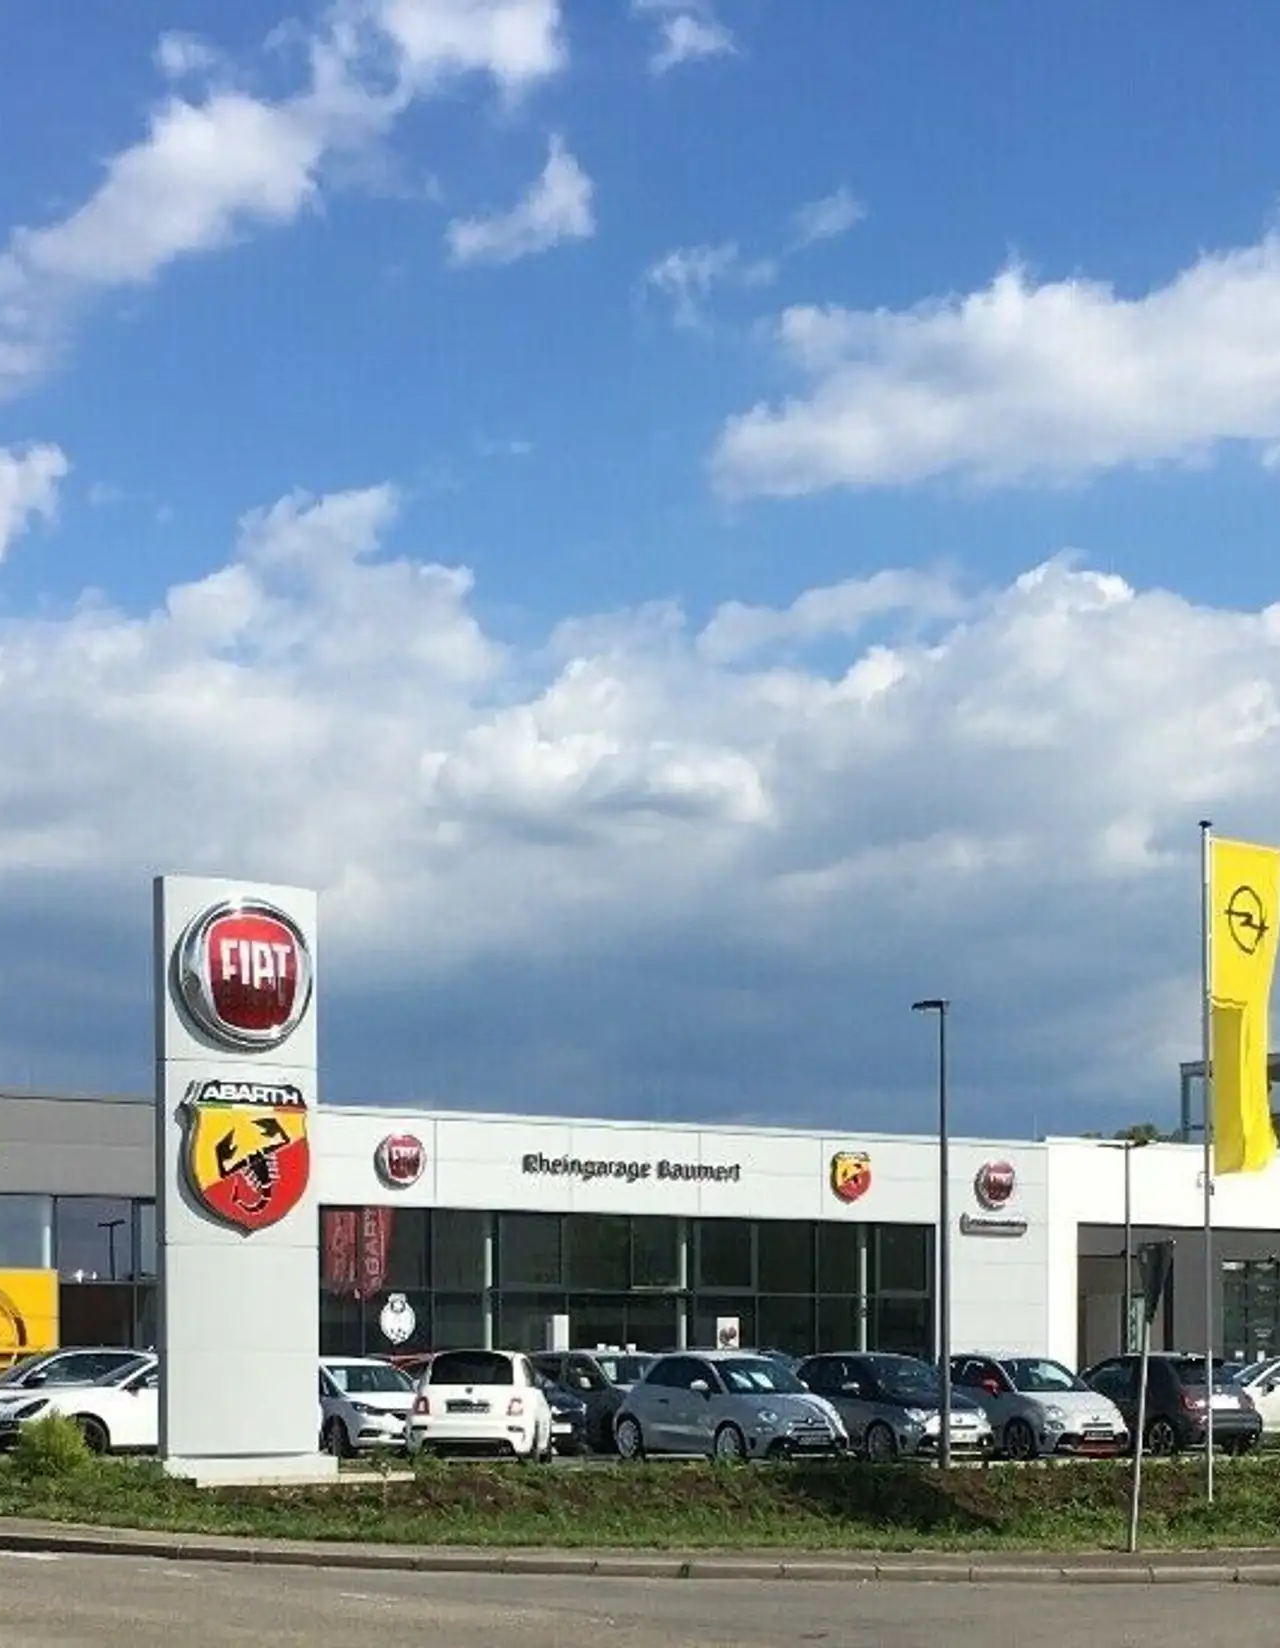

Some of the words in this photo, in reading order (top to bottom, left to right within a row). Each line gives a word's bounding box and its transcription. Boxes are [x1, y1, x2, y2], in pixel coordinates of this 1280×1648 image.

[220, 938, 291, 1006] FIAT
[202, 1084, 299, 1105] ABARTH
[521, 1152, 652, 1184] Rheingarage
[655, 1158, 742, 1182] Baumert
